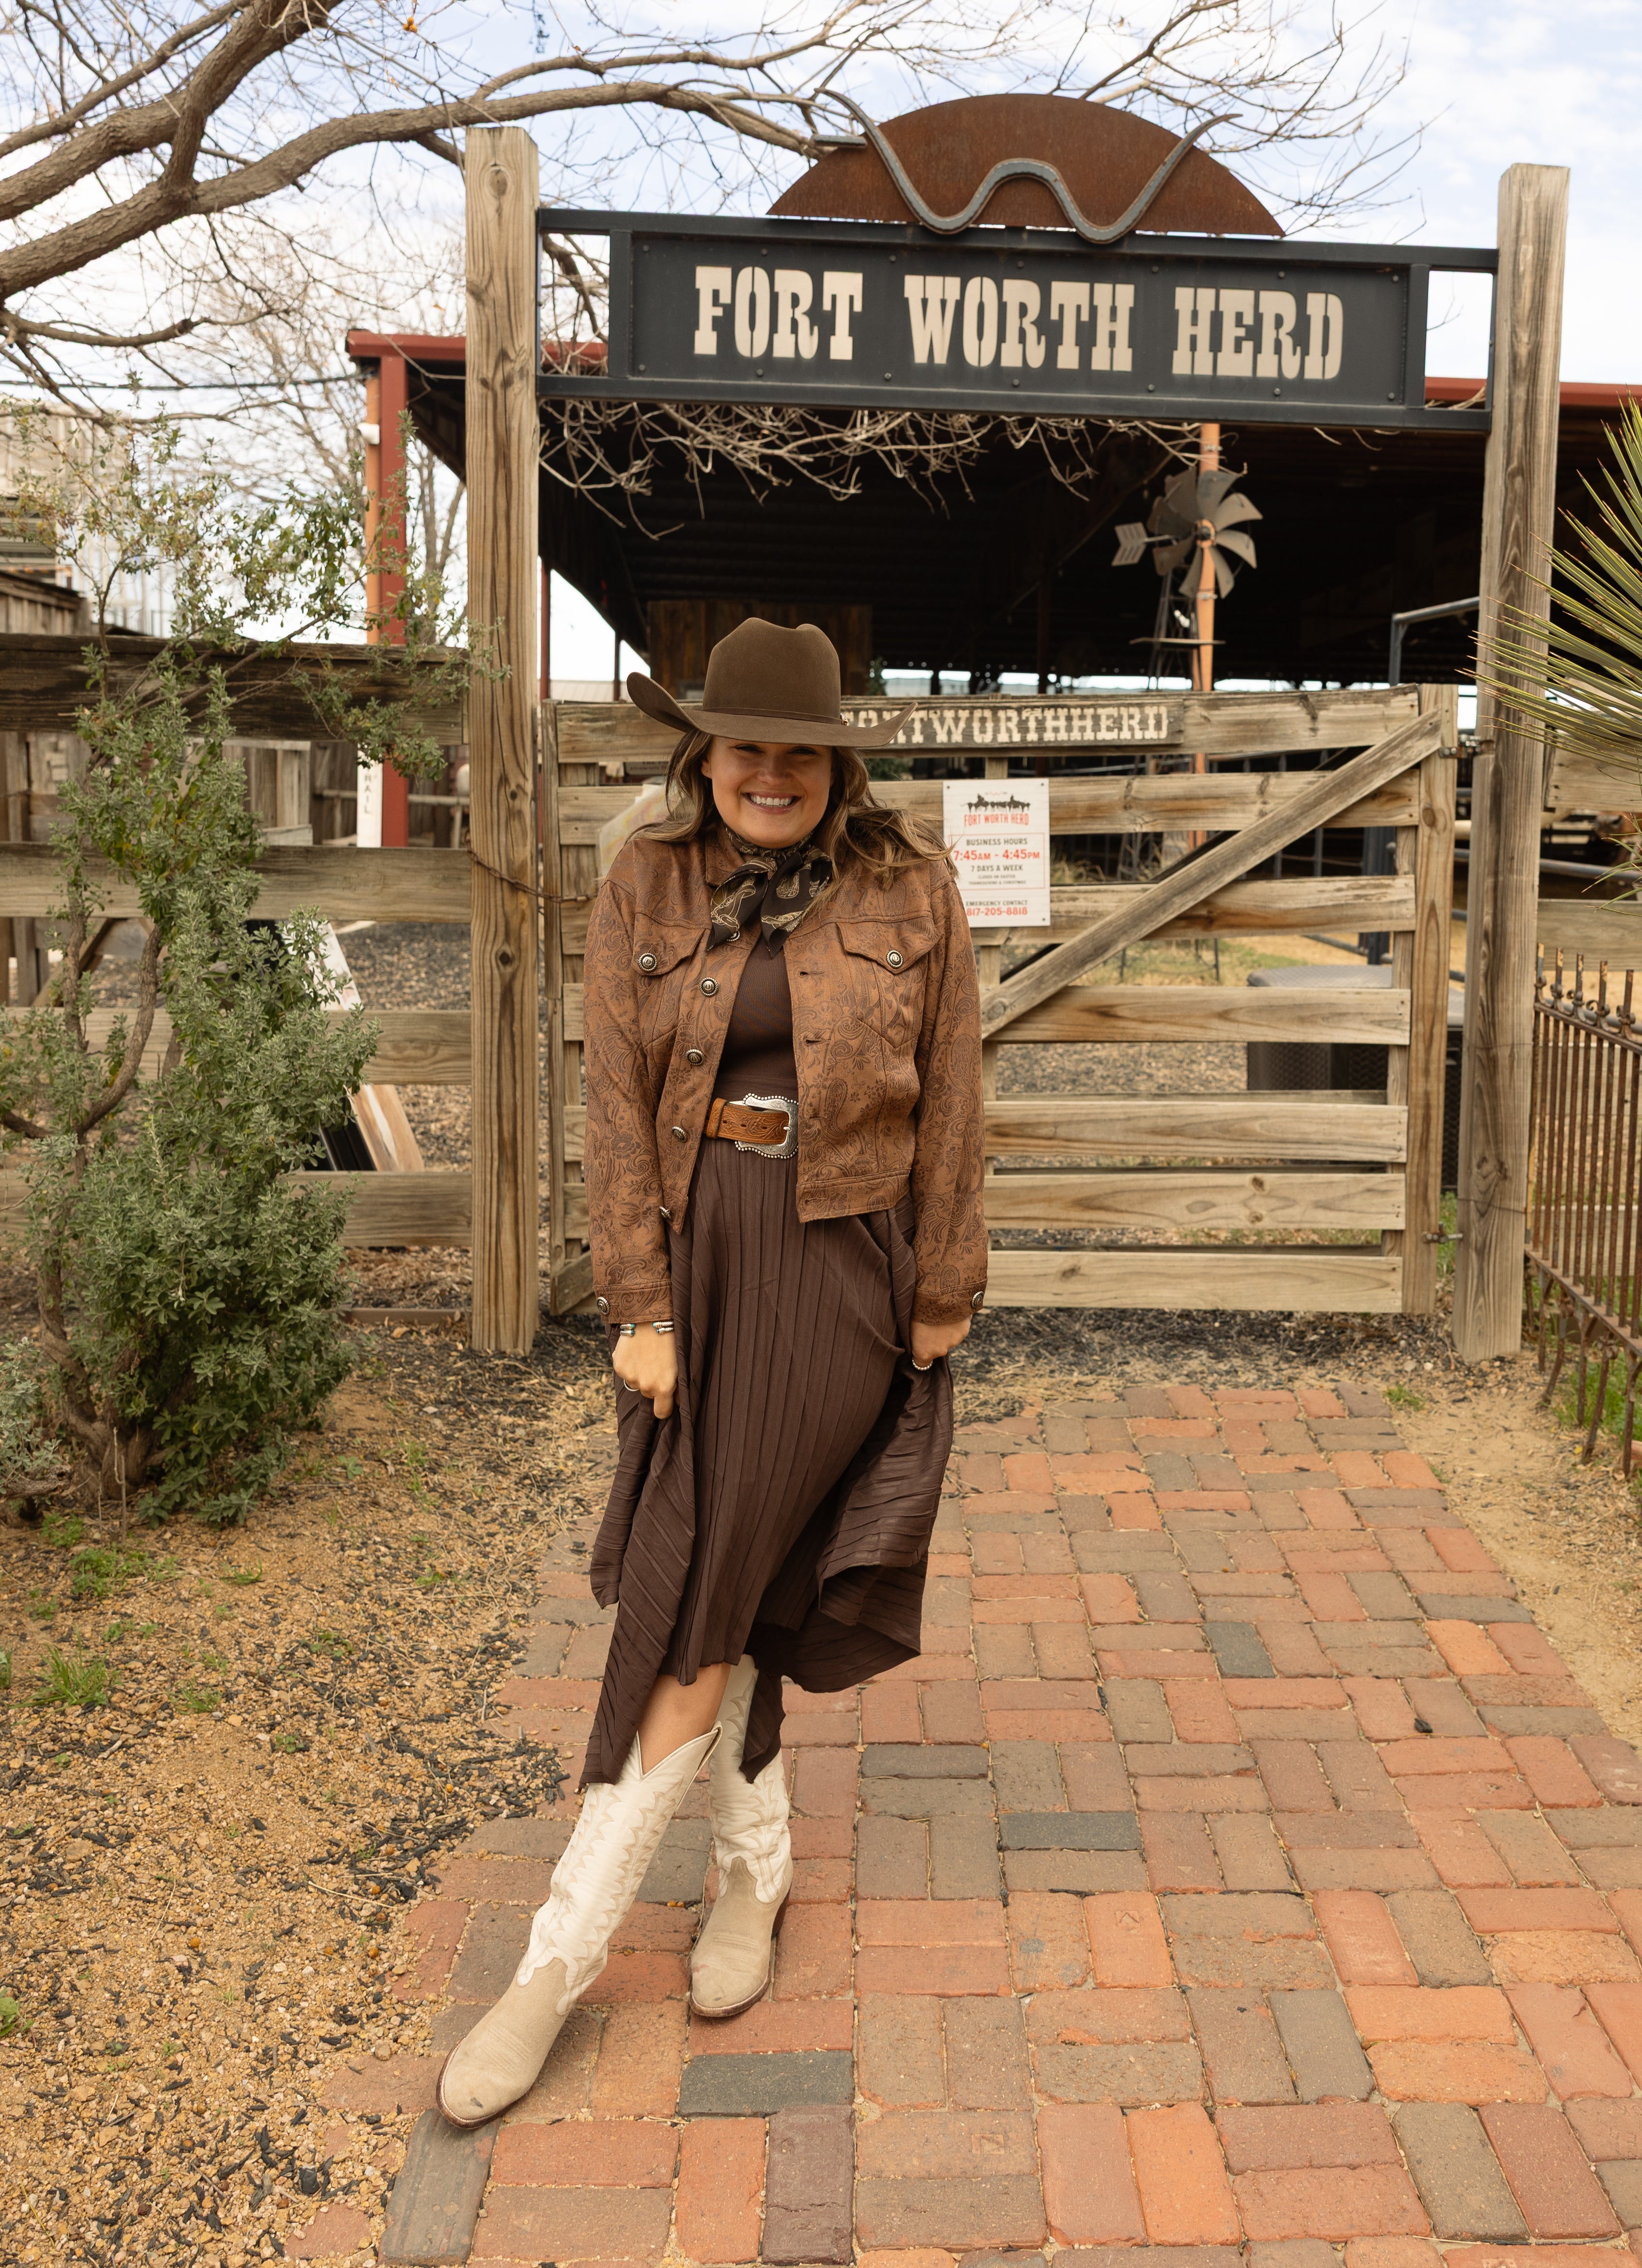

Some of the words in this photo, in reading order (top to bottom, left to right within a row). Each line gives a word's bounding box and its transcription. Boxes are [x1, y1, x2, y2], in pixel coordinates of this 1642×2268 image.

[694, 266, 863, 360] FORT
[904, 274, 1135, 372] WORTH
[1172, 287, 1343, 380] HERD
[840, 705, 1168, 744] OTWORTHHERD
[964, 814, 981, 826] FORT
[984, 814, 1009, 824] WORTH
[953, 850, 991, 861] 7:45AM
[1002, 849, 1040, 860] 4:45PM
[967, 907, 1028, 916] 817-205-8818
[1223, 1836, 1242, 1864] BRCK
